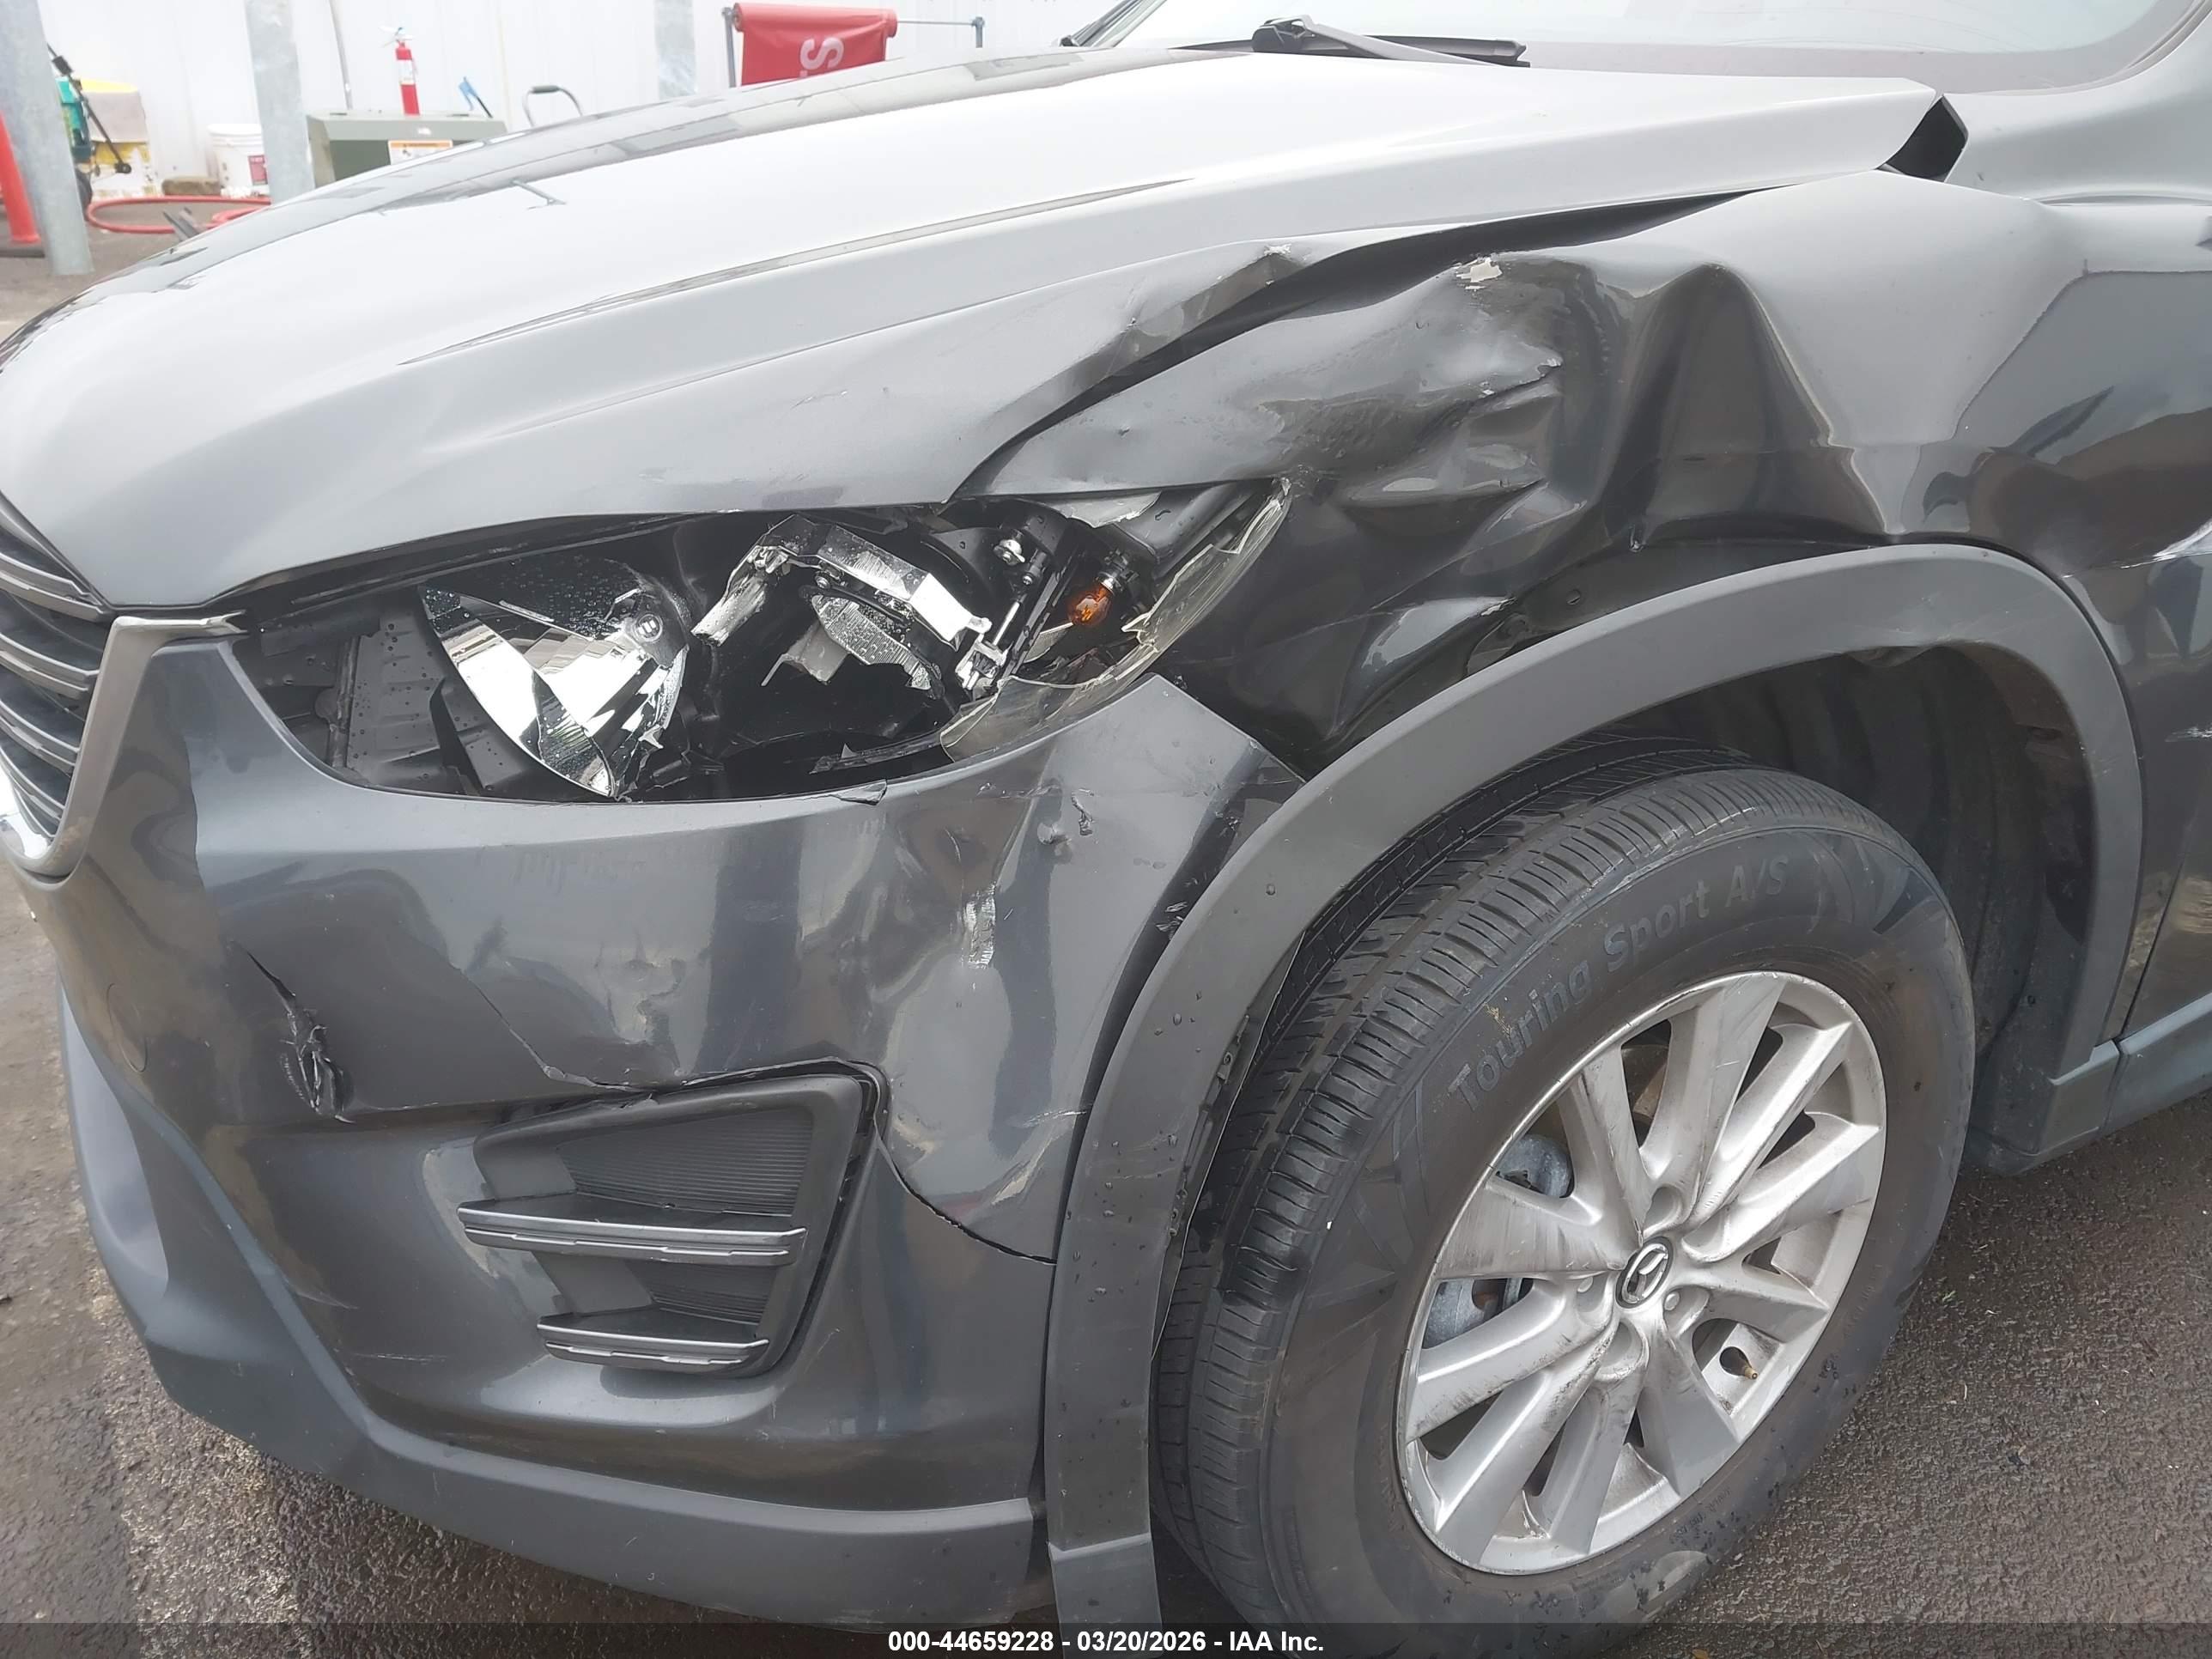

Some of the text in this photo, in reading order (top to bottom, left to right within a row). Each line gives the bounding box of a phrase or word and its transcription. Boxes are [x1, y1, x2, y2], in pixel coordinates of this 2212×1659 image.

[800, 37, 844, 76] S
[1448, 855, 1789, 1113] Touring Sport A/S
